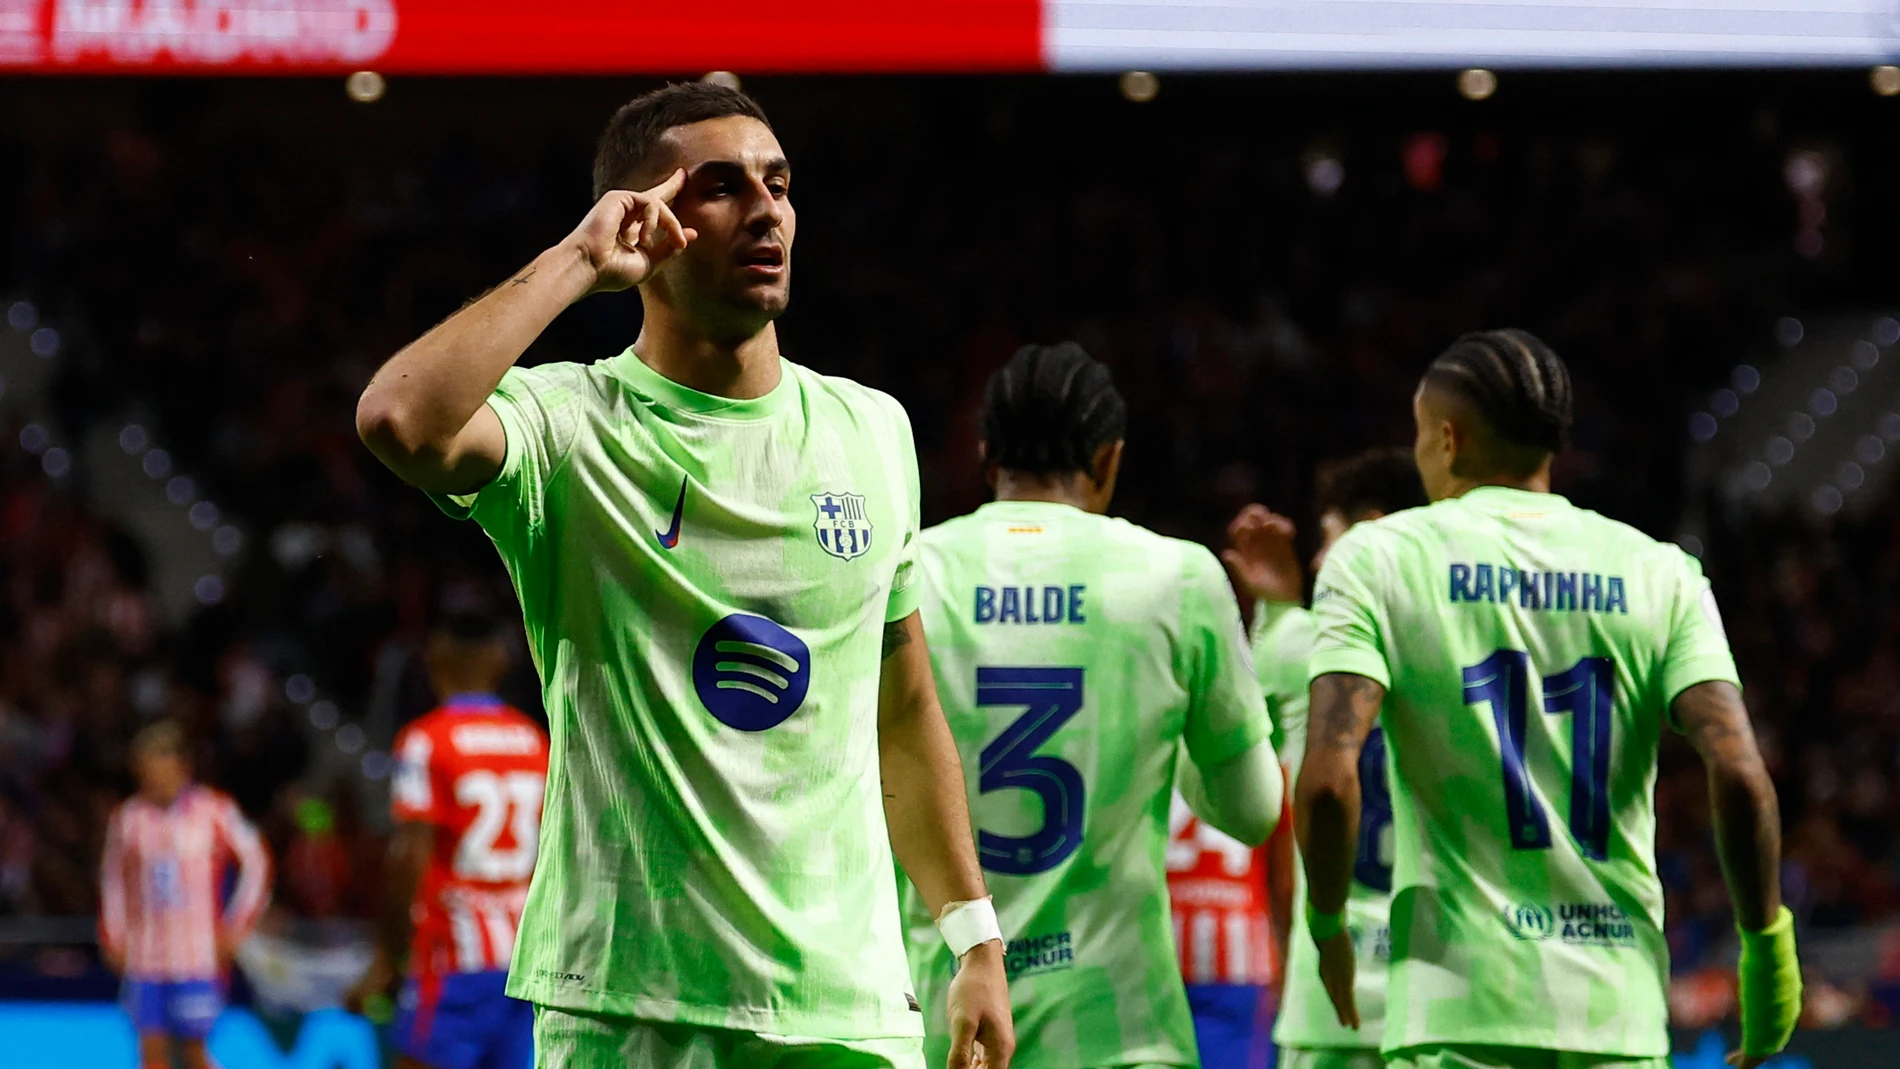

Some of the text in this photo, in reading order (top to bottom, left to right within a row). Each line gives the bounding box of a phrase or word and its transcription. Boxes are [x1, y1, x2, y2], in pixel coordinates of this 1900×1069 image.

[976, 585, 1087, 625] BALDE
[1450, 563, 1628, 614] RAPHINHA
[976, 667, 1084, 876] 3
[1463, 648, 1616, 862] 11
[1560, 903, 1628, 920] UNHC
[1562, 922, 1634, 939] ACNUR
